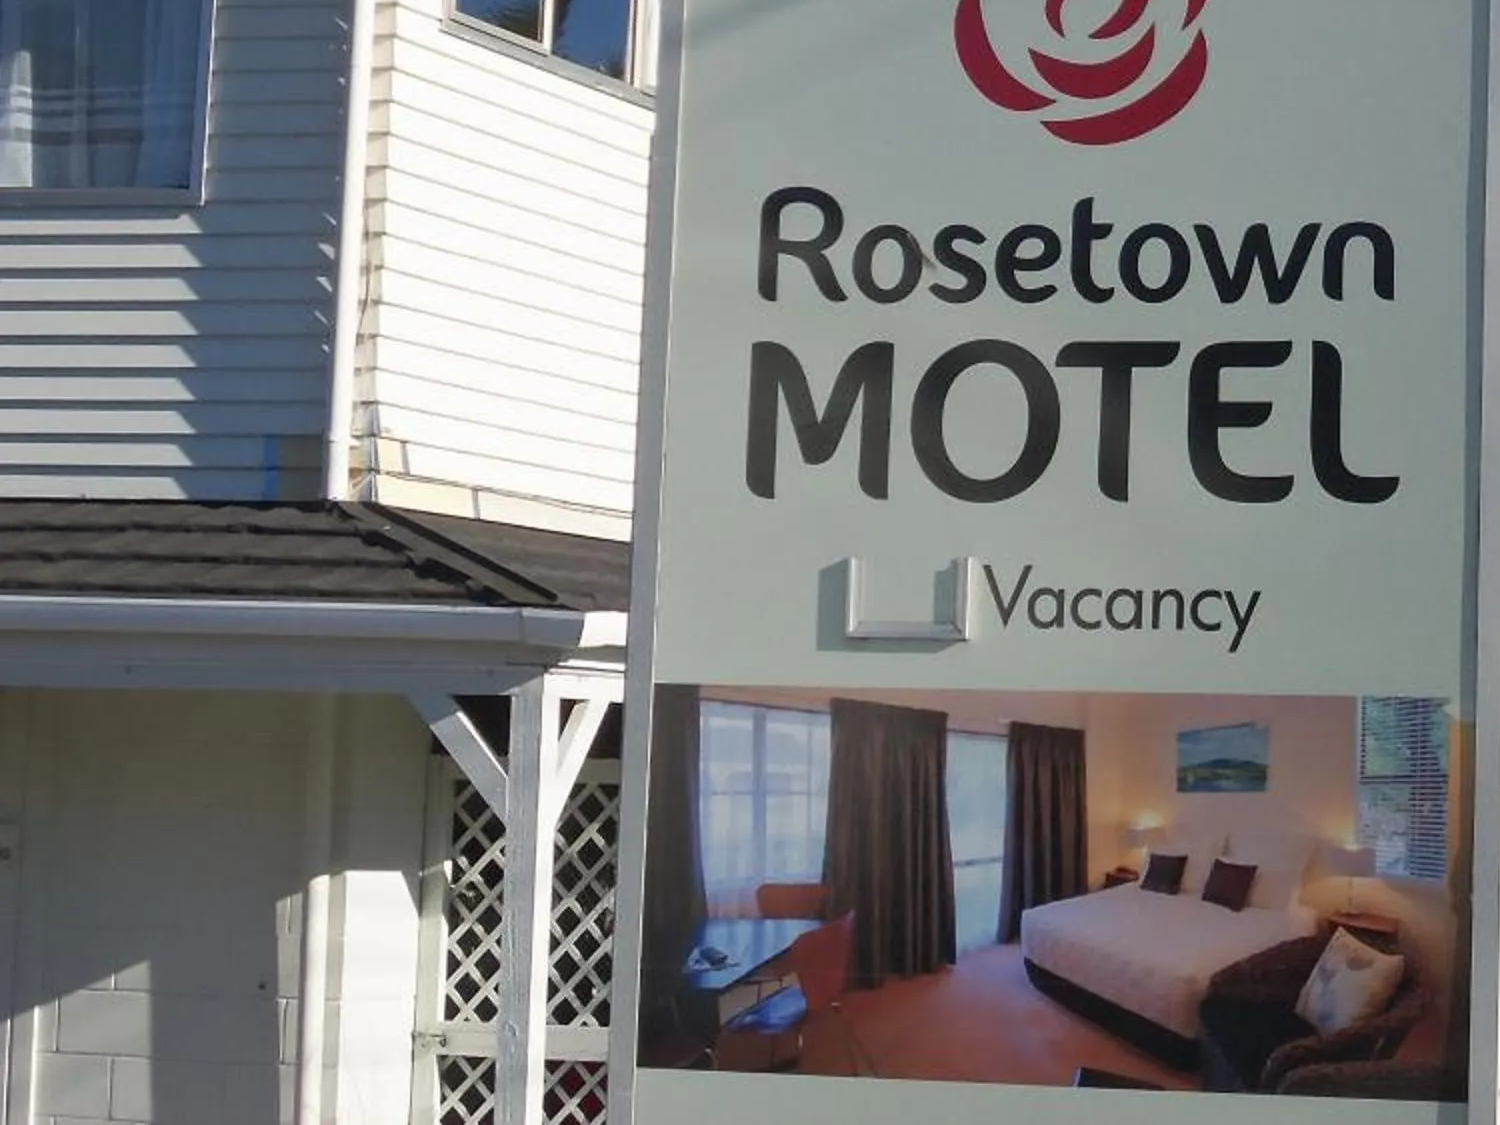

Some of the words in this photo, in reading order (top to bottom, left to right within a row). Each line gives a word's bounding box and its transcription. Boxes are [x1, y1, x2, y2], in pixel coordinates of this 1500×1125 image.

[757, 186, 1395, 305] Rosetown
[745, 338, 1401, 505] MOTEL
[983, 564, 1262, 654] Vacancy
